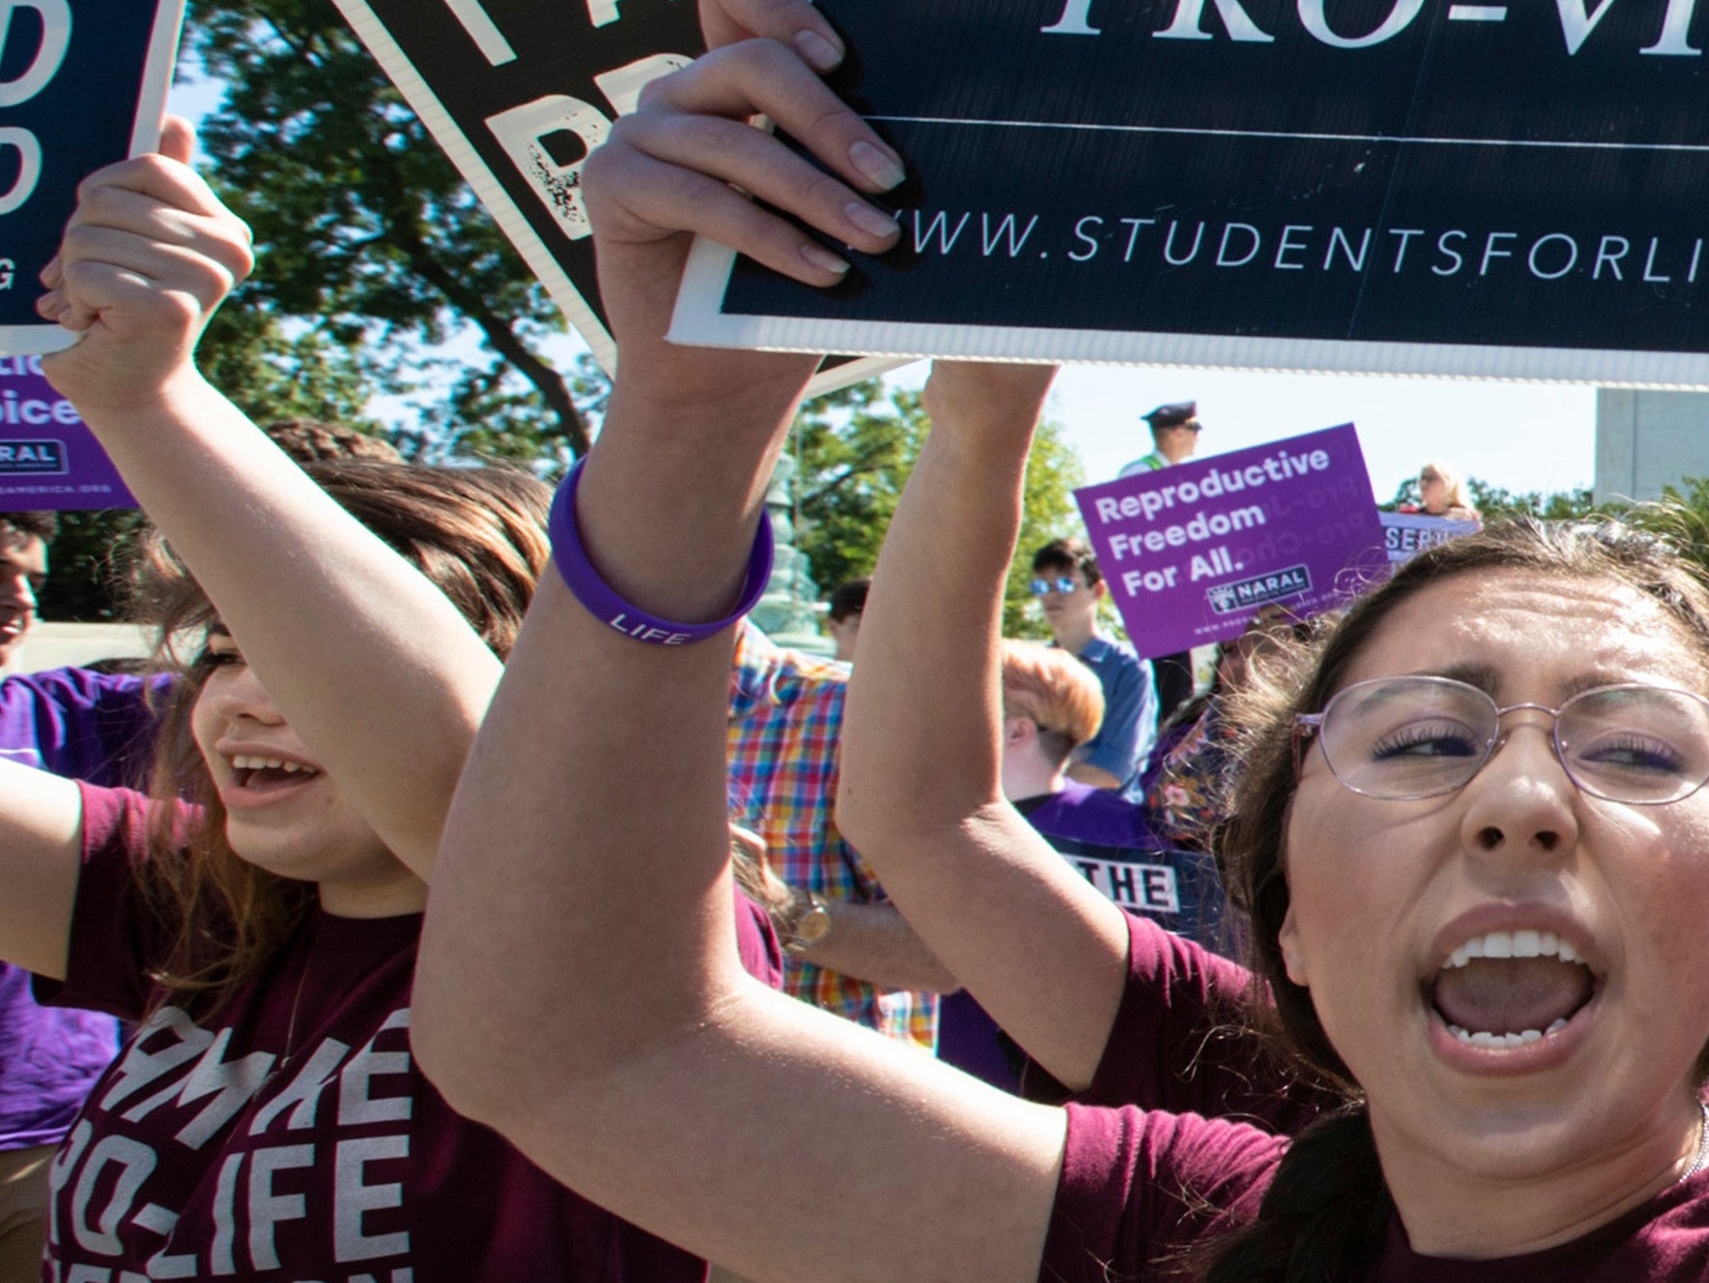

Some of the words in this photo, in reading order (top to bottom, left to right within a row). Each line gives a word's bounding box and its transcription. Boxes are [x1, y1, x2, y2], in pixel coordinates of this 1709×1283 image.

[0, 389, 83, 425] ice
[1095, 449, 1331, 524] Reproductive
[1108, 504, 1267, 561] Freedom
[1121, 565, 1178, 598] For
[1190, 545, 1244, 583] All.
[1236, 570, 1305, 599] NARAL
[610, 613, 692, 646] LIFE
[1076, 861, 1170, 907] THE
